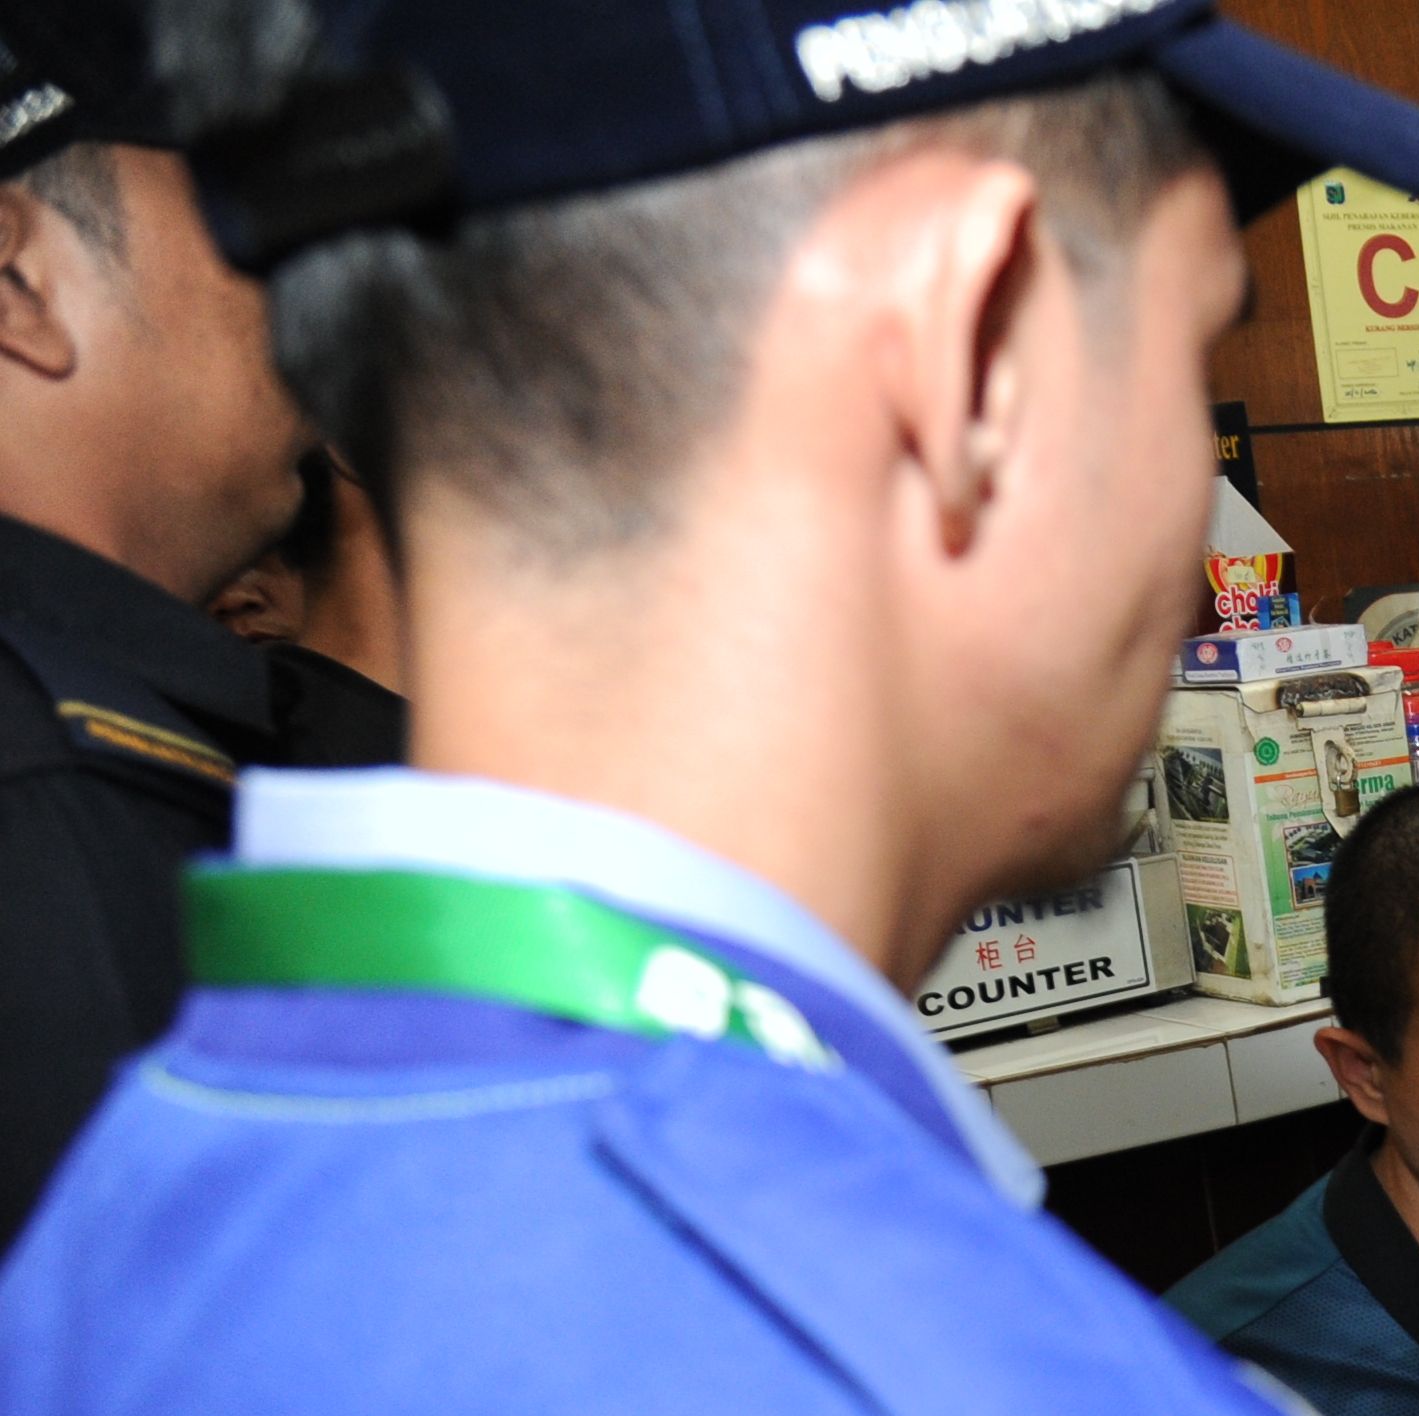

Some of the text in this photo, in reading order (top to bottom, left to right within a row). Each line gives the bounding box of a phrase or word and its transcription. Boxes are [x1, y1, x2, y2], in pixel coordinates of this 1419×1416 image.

[1357, 233, 1419, 319] C
[975, 934, 1037, 972] 柜台
[916, 956, 1116, 1017] COUNTER
